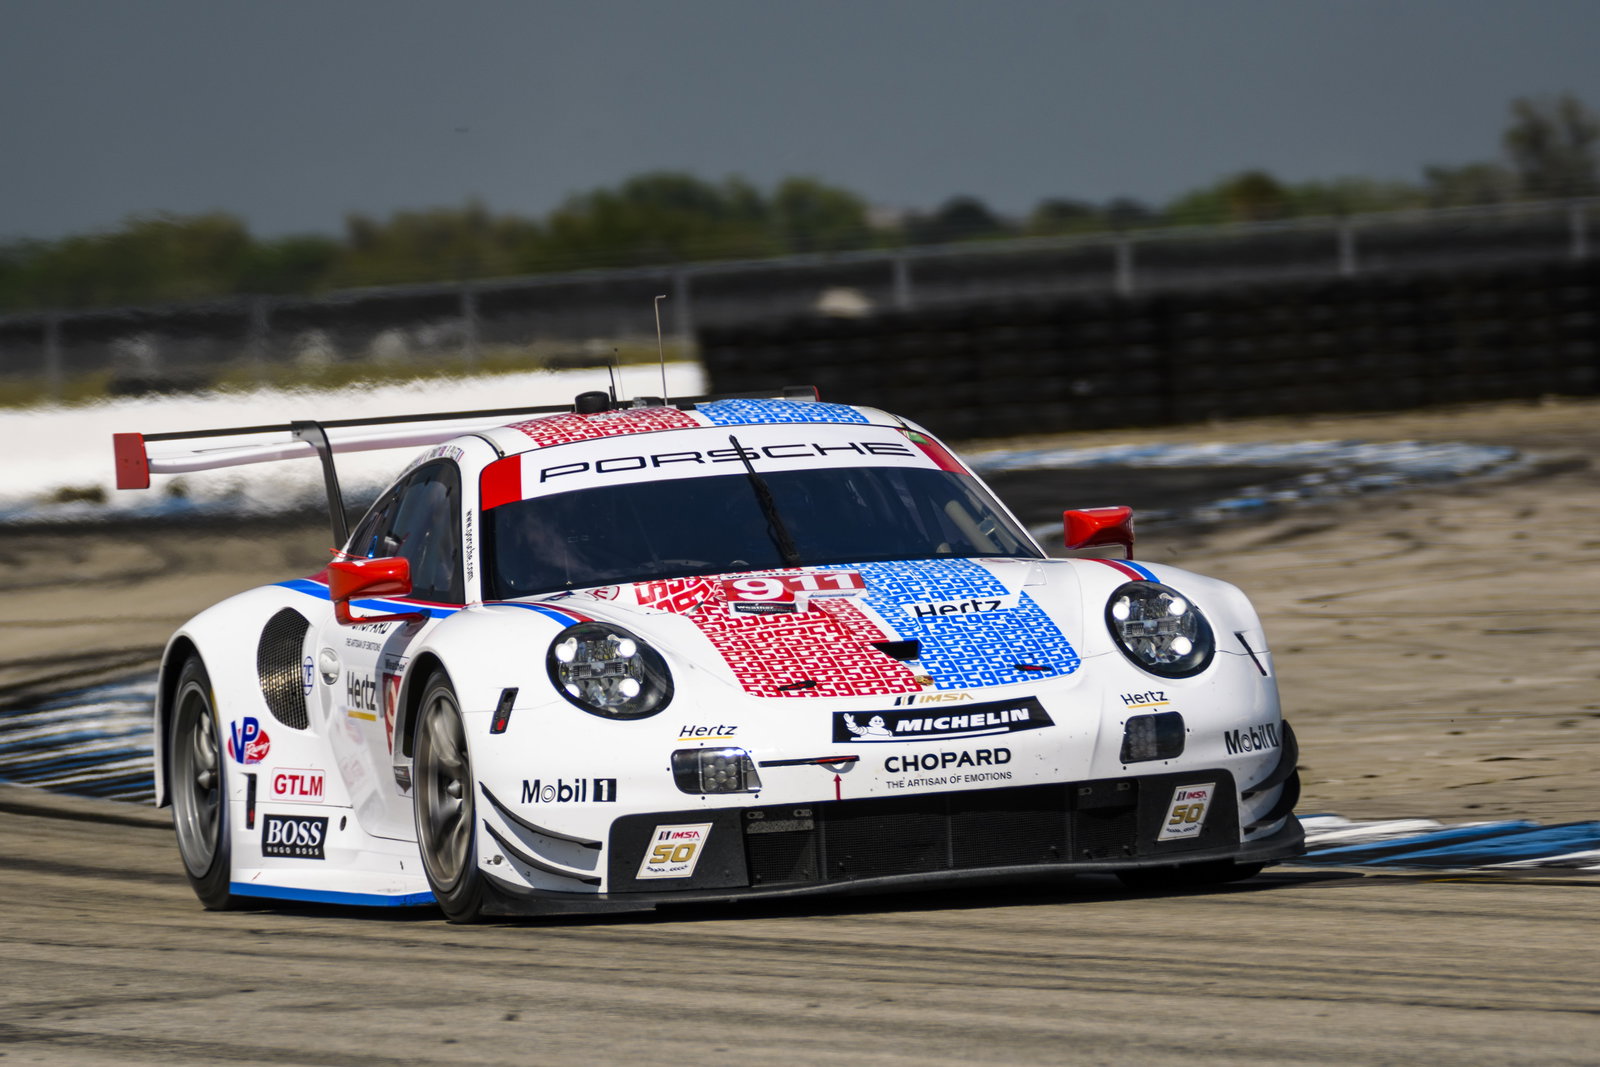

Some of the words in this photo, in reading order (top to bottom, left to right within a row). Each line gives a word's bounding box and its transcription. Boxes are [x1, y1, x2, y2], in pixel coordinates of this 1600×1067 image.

[539, 441, 916, 483] PORSCHE
[732, 573, 855, 601] 911
[914, 599, 1001, 617] Hertz
[347, 670, 377, 711] Hertz
[919, 692, 974, 704] IMSA
[1120, 690, 1168, 705] Hertz
[679, 724, 738, 738] Hertz
[895, 708, 1030, 732] MICHELIN
[231, 717, 259, 764] VP
[1224, 725, 1268, 755] Mobil
[884, 748, 1011, 773] CHOPARD
[274, 774, 324, 796] GTLM
[521, 778, 587, 804] Mobil
[596, 778, 614, 802] 1
[886, 780, 905, 790] THE
[907, 776, 947, 788] ARTISAN
[950, 774, 962, 784] OF
[964, 771, 1012, 783] EMOTIONS
[1168, 803, 1204, 825] 50
[267, 819, 322, 846] BOSS
[671, 830, 700, 840] IMSA
[267, 846, 291, 854] HUGO
[295, 847, 320, 856] BOSS
[649, 843, 697, 864] 50
